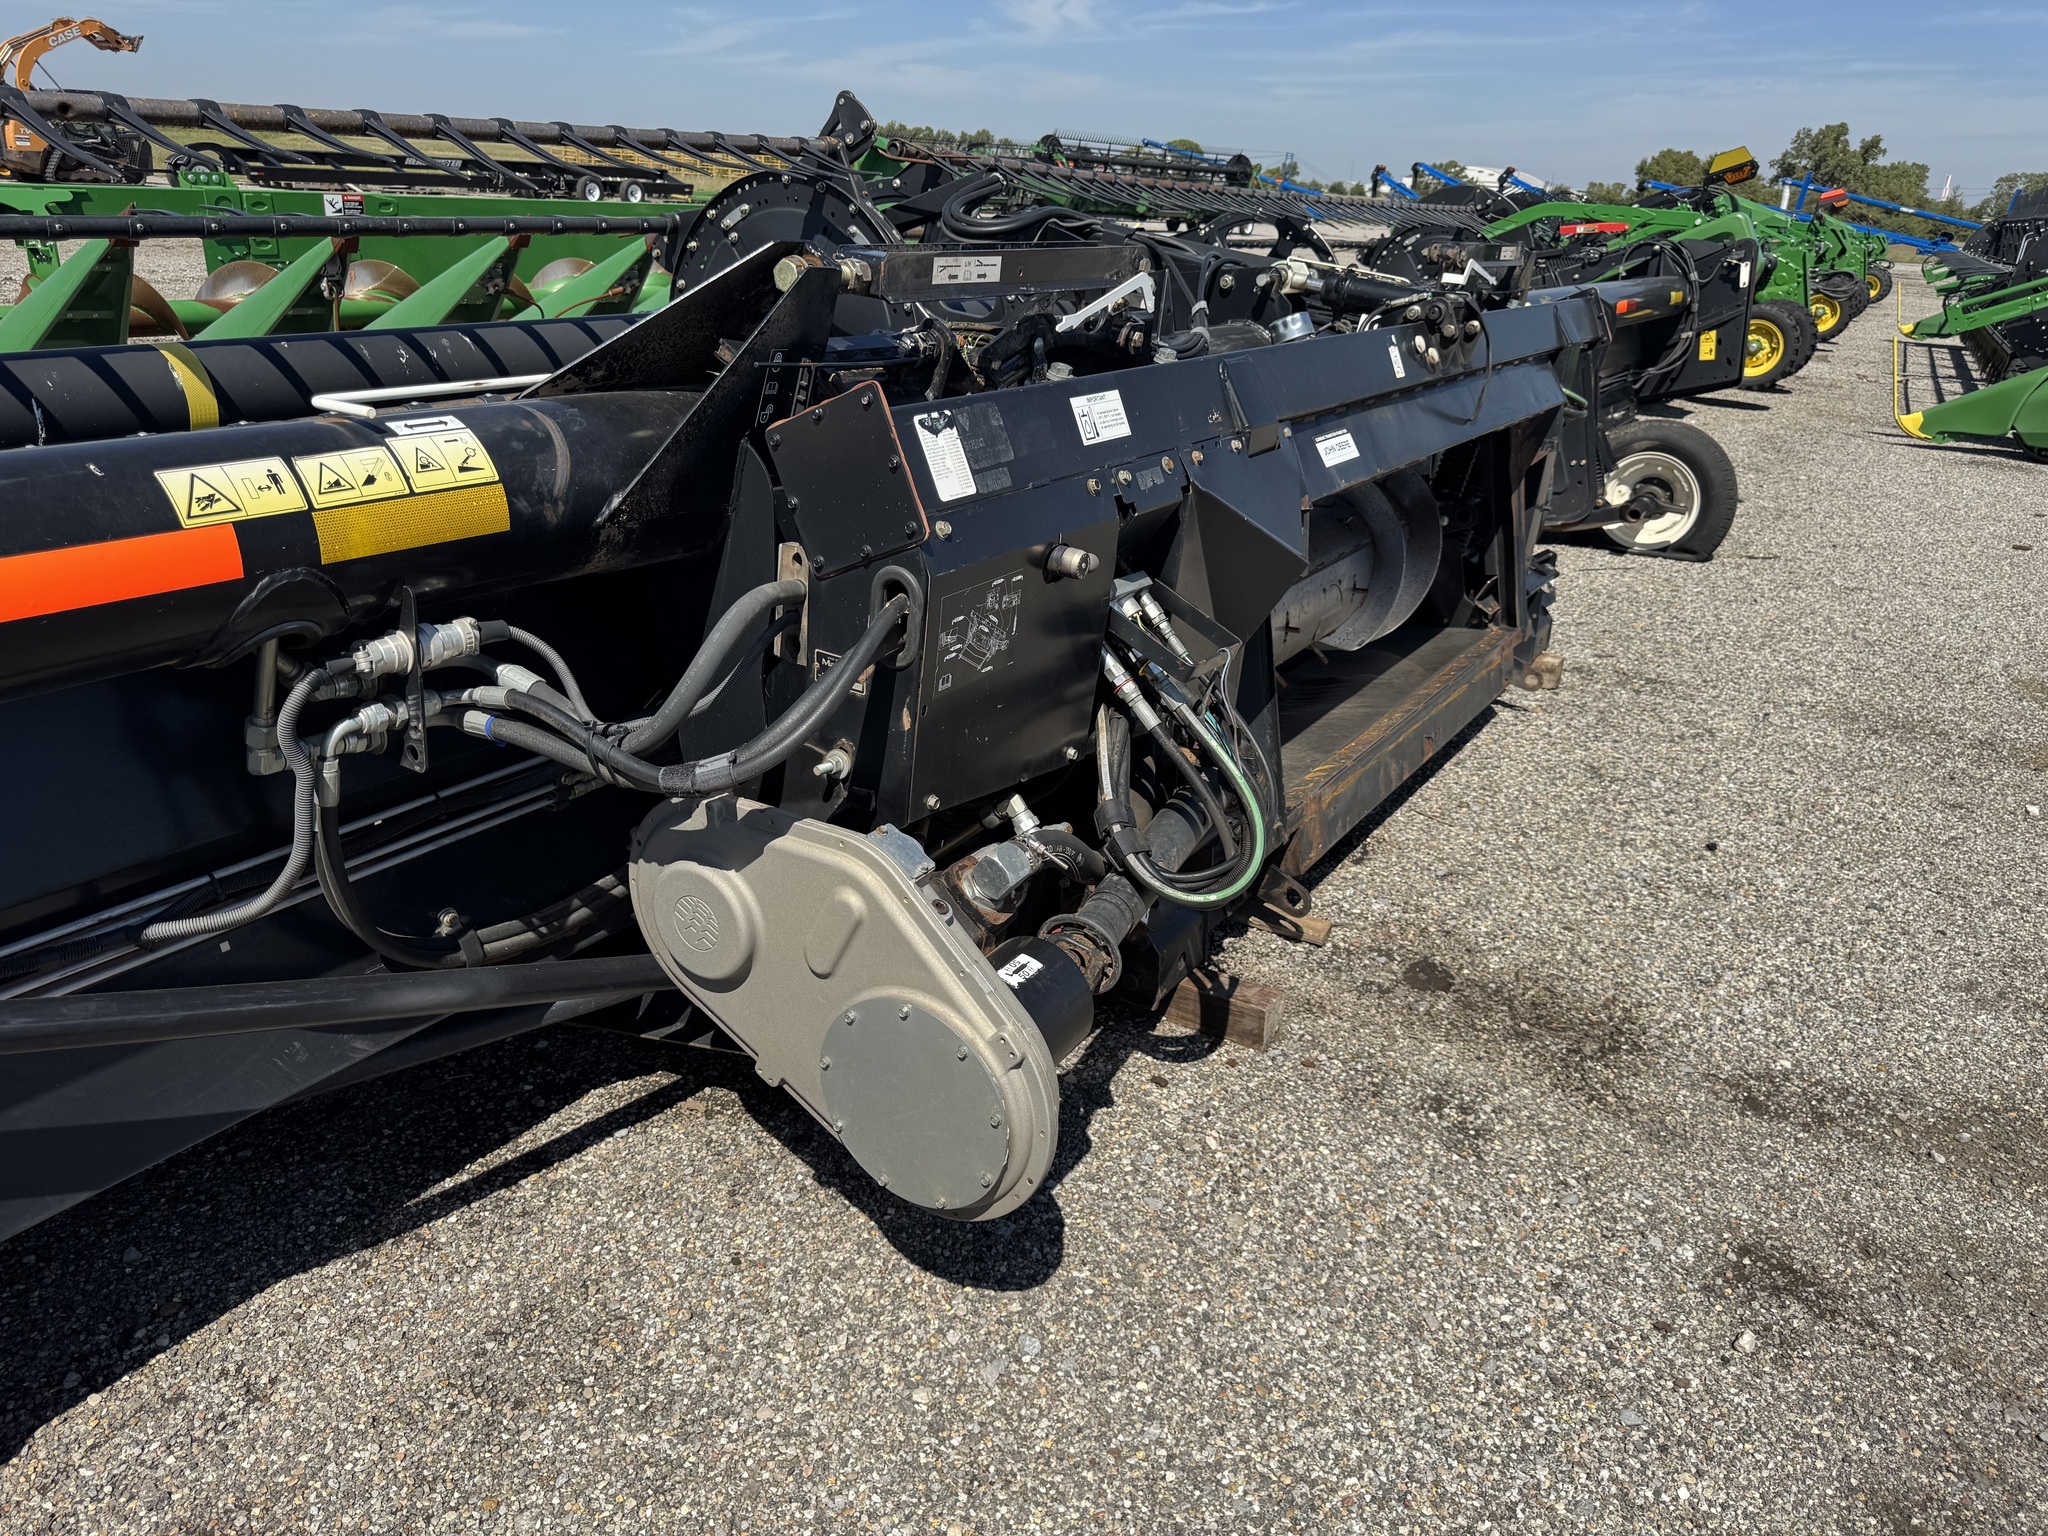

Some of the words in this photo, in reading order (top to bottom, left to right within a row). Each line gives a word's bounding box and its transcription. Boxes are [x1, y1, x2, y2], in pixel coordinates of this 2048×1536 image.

[48, 25, 82, 47] CASE
[1323, 444, 1337, 456] JOHN
[1335, 439, 1352, 452] DEERE
